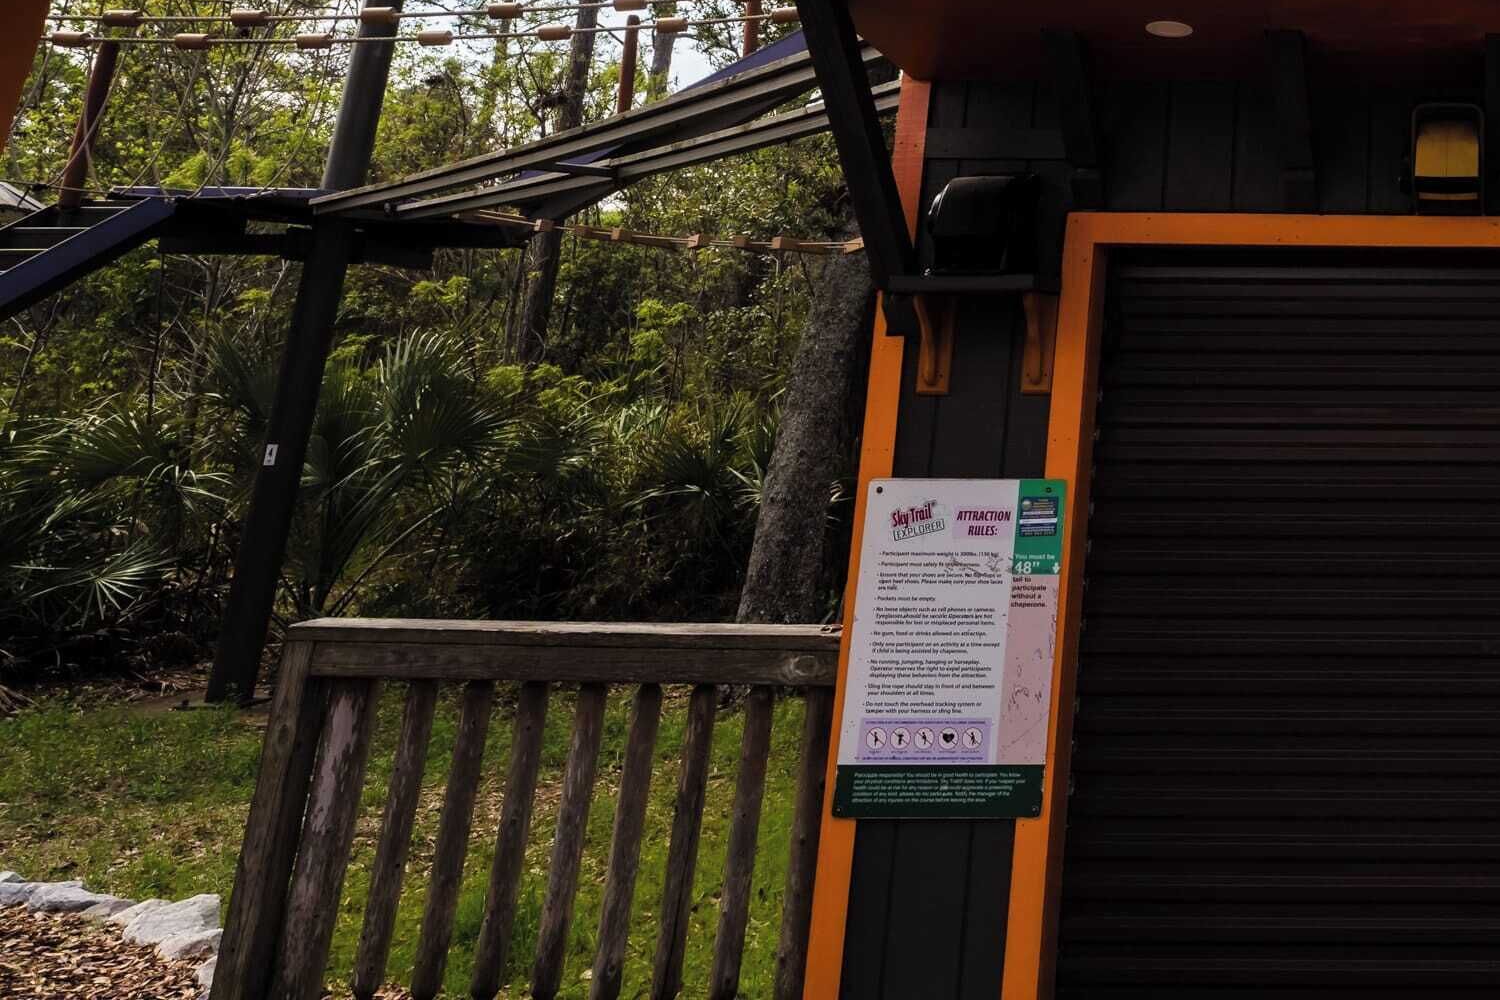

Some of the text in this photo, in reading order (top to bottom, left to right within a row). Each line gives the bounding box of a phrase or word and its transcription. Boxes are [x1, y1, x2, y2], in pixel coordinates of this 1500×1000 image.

[892, 503, 932, 529] Sky Trail
[957, 510, 1012, 522] ATTRACTION
[896, 520, 943, 539] EXPLORER
[968, 525, 998, 536] RULES:
